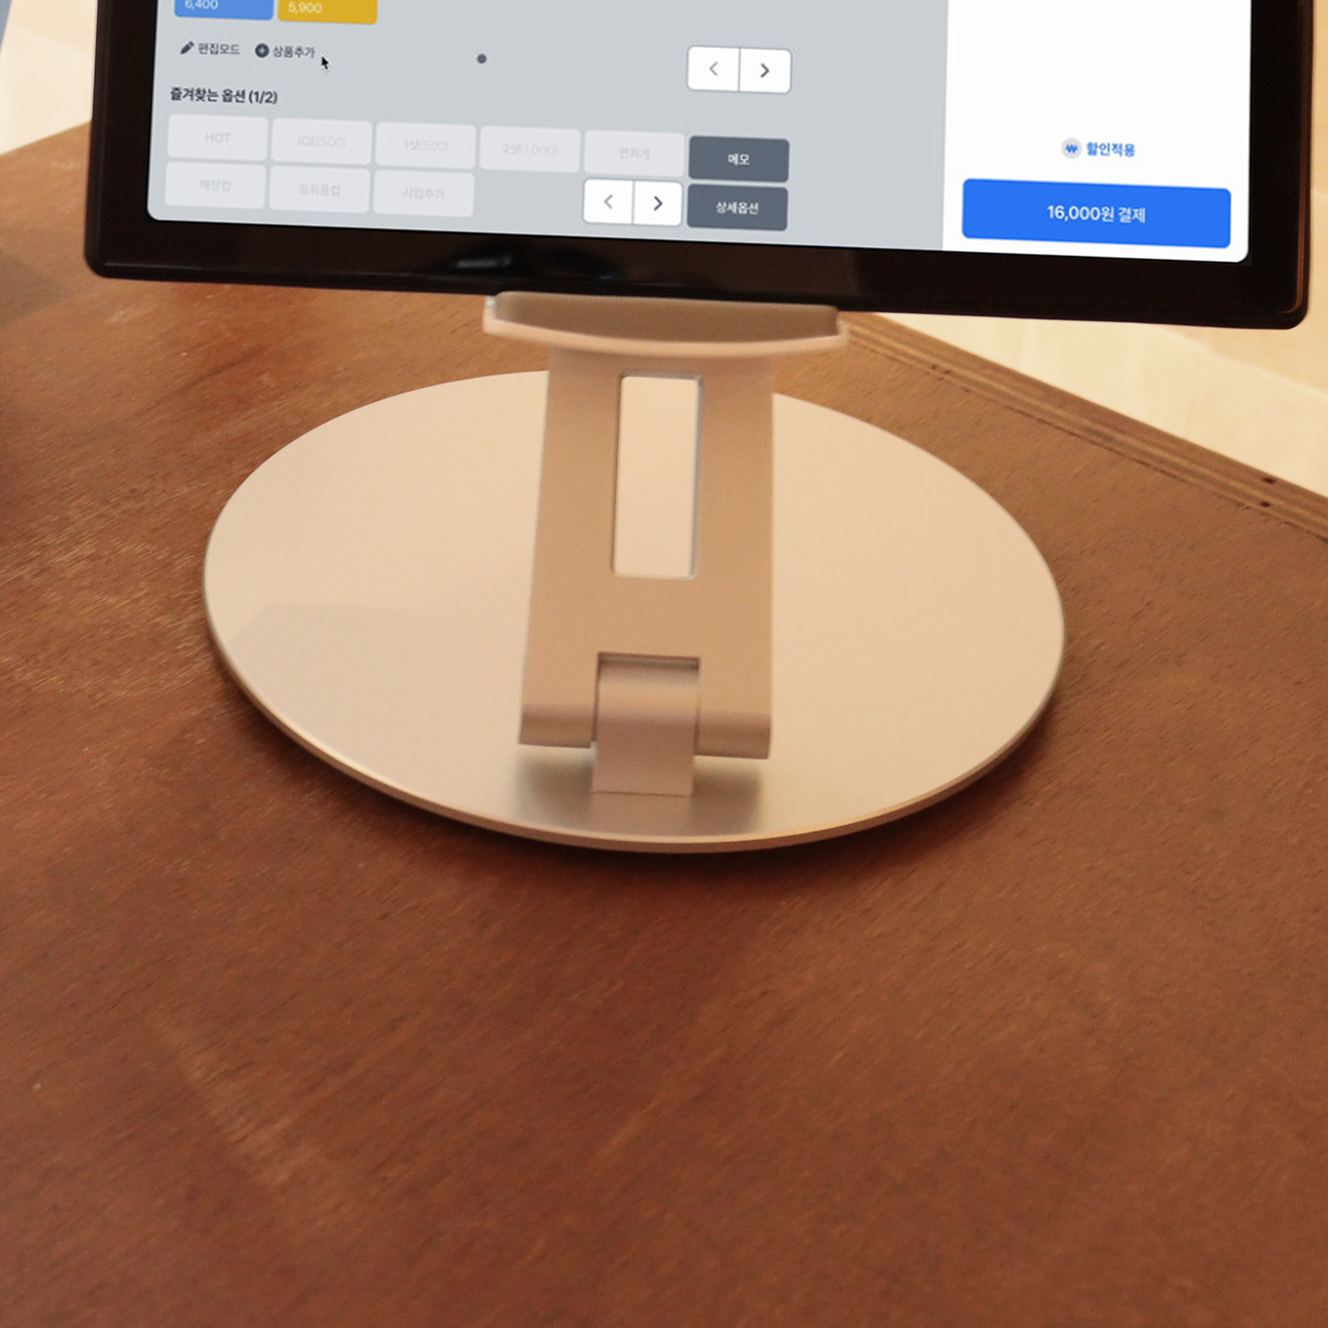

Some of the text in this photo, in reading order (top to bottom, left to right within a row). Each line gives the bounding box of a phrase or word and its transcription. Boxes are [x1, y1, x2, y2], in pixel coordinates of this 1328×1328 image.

[289, 2, 323, 14] 5,900
[198, 43, 240, 55] 편집모드
[273, 46, 315, 58] 상품추가
[170, 87, 277, 104] 즐겨찾는 옵션 (1/2)
[203, 131, 231, 144] HOT
[1087, 142, 1135, 157] 할인적용
[728, 154, 749, 165] 메모
[716, 202, 758, 215] 상세옵션
[1048, 205, 1145, 223] 16,000원 결제
